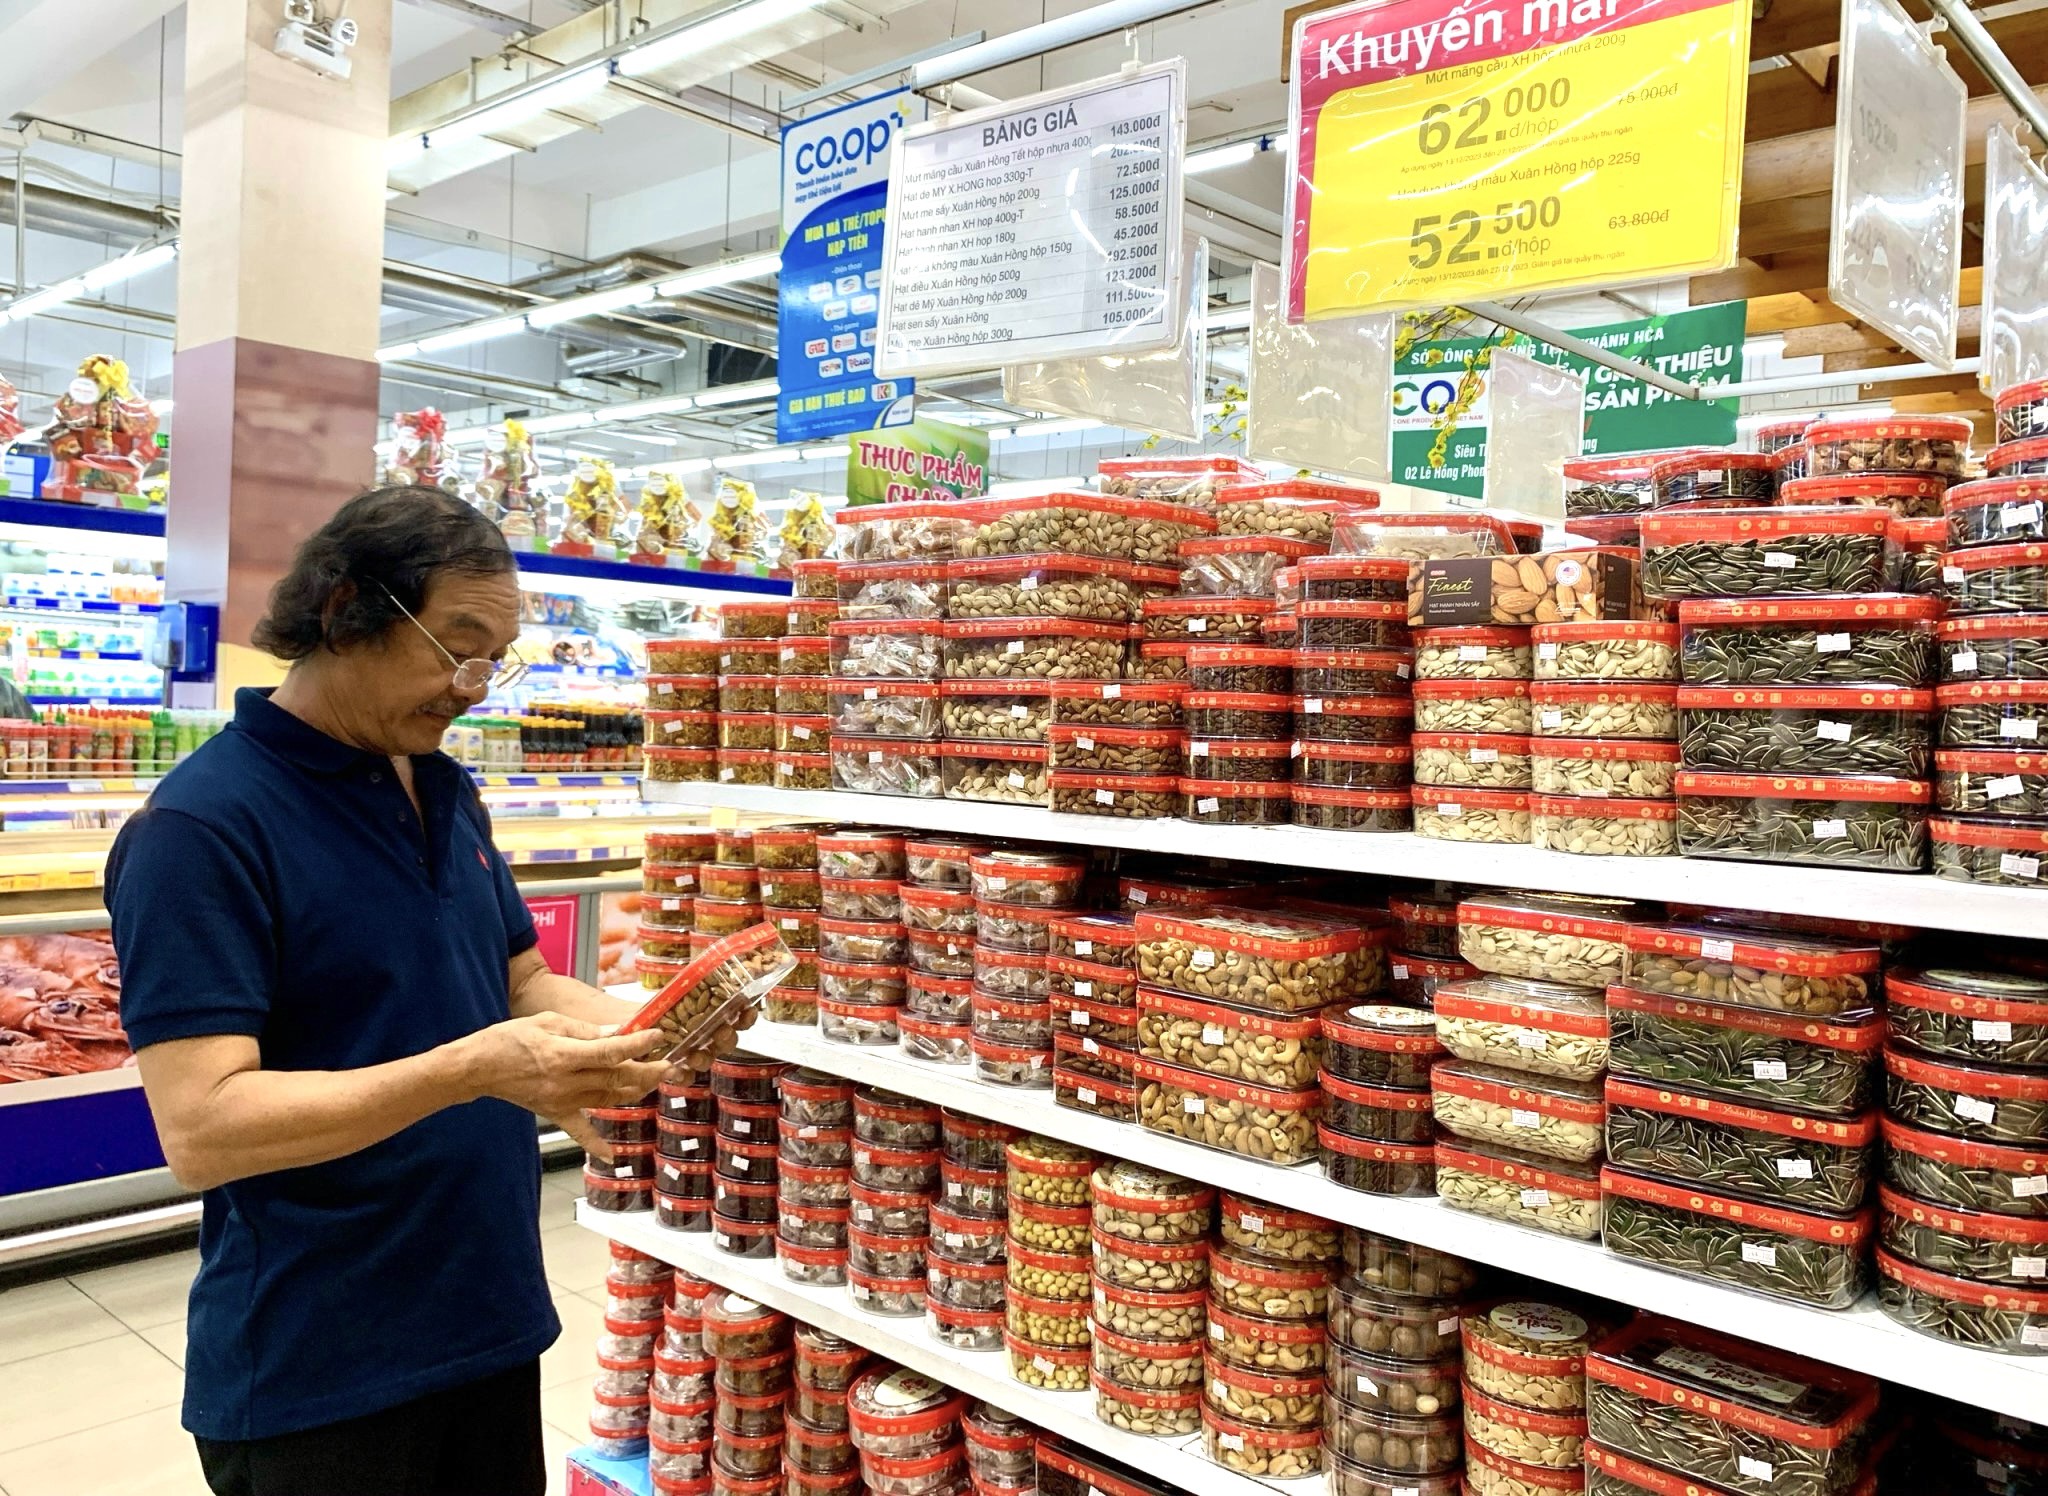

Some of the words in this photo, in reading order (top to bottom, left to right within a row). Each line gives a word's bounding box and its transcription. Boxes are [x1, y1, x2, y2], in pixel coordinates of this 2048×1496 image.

[1319, 0, 1502, 79] Khuyến
[1425, 69, 1449, 85] Mứt
[1511, 53, 1530, 67] XH
[1594, 32, 1627, 52] 200g
[983, 117, 1037, 148] BẢNG
[1043, 103, 1078, 133] GIÁ
[1110, 115, 1161, 137] 143.000đ
[1510, 117, 1559, 139] đ/hộp
[965, 160, 986, 172] Xuân
[987, 152, 1010, 167] Hồng
[1011, 148, 1026, 161] Tết
[1027, 145, 1045, 160] hộp
[1046, 141, 1070, 154] nhựa
[1510, 164, 1539, 183] Xuân
[1544, 158, 1577, 178] Hồng
[1580, 155, 1605, 174] hộp
[1608, 151, 1641, 168] 225g
[1117, 158, 1160, 178] 72.500đ
[932, 186, 947, 198] MY
[948, 178, 985, 195] X.HONG
[1003, 167, 1034, 183] 330g-T
[1109, 179, 1160, 200] 125.000đ
[935, 202, 950, 216] sấy
[952, 200, 973, 213] Xuân
[975, 194, 998, 209] Hồng
[1017, 187, 1040, 200] 200g
[1115, 200, 1159, 220] 58.500đ
[962, 217, 976, 229] XH
[994, 209, 1025, 223] 400g-T
[1608, 208, 1670, 230] 63.800đ
[960, 236, 974, 248] XH
[995, 231, 1016, 244] 180g
[1114, 222, 1158, 241] 45.200đ
[959, 255, 979, 267] màu
[980, 252, 1003, 266] Xuân
[1005, 247, 1028, 263] Hồng
[1050, 241, 1072, 254] 150g
[1501, 236, 1551, 257] đ/hộp
[911, 279, 929, 292] điều
[931, 275, 953, 289] Xuân
[955, 272, 979, 287] Hồng
[999, 269, 1021, 281] 500g
[1105, 264, 1157, 283] 123.200đ
[936, 294, 959, 307] Xuân
[961, 291, 985, 306] Hồng
[1005, 287, 1027, 299] 200g
[907, 318, 923, 329] sen
[925, 315, 940, 329] sấy
[941, 312, 964, 326] Xuân
[966, 311, 989, 324] Hồng
[923, 332, 946, 346] Xuân
[947, 331, 971, 345] Hồng
[990, 328, 1013, 340] 300g
[1584, 383, 1640, 412] SẢN
[1454, 443, 1475, 459] Siêu
[857, 440, 916, 480] THỰC
[921, 452, 983, 490] PHẨM
[1405, 465, 1418, 480] 02
[1420, 462, 1431, 479] Lê
[1427, 577, 1474, 596] Finest
